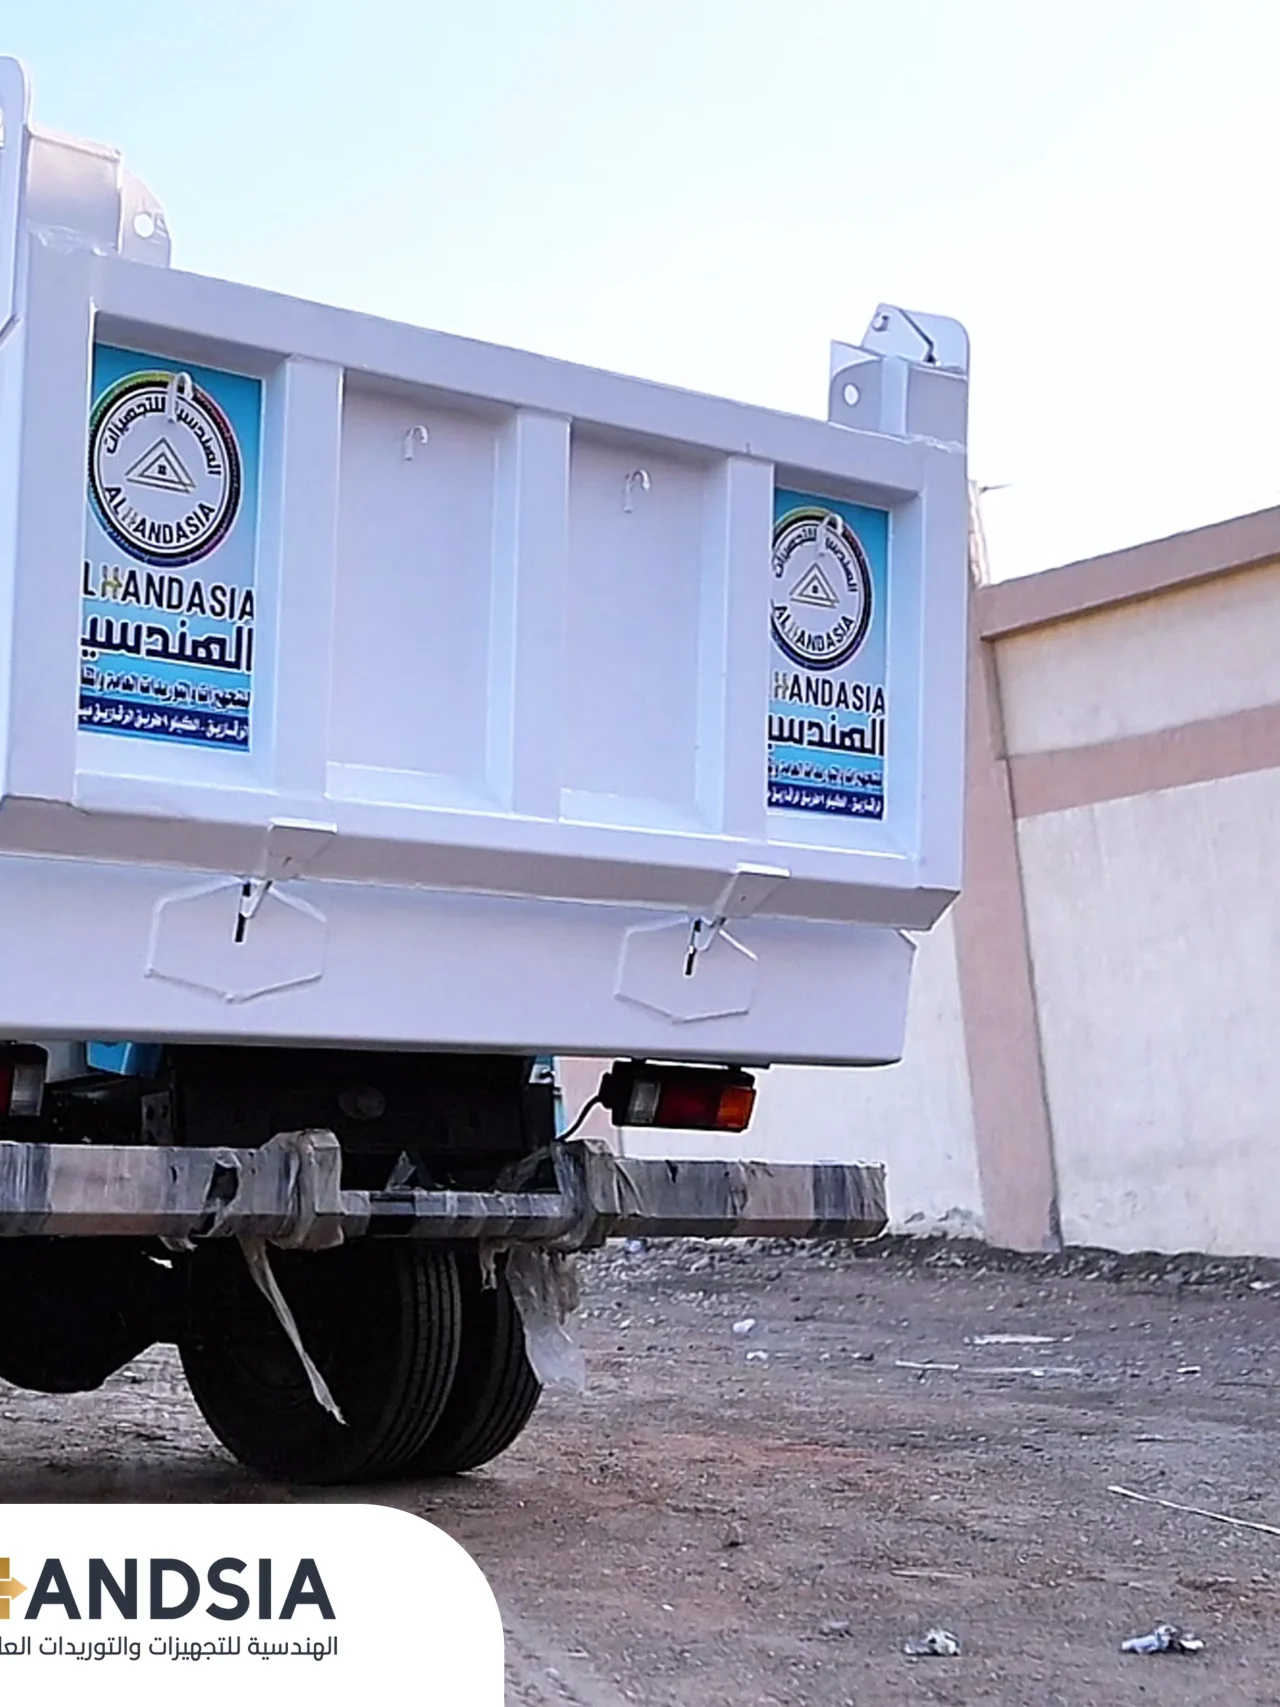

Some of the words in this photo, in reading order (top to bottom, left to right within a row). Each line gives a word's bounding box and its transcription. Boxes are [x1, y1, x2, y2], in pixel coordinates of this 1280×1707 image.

[105, 486, 216, 545] ALHANDASIA
[82, 560, 255, 622] LHANDASIA
[80, 615, 254, 672] الهندسي
[773, 670, 886, 715] HANDASIA
